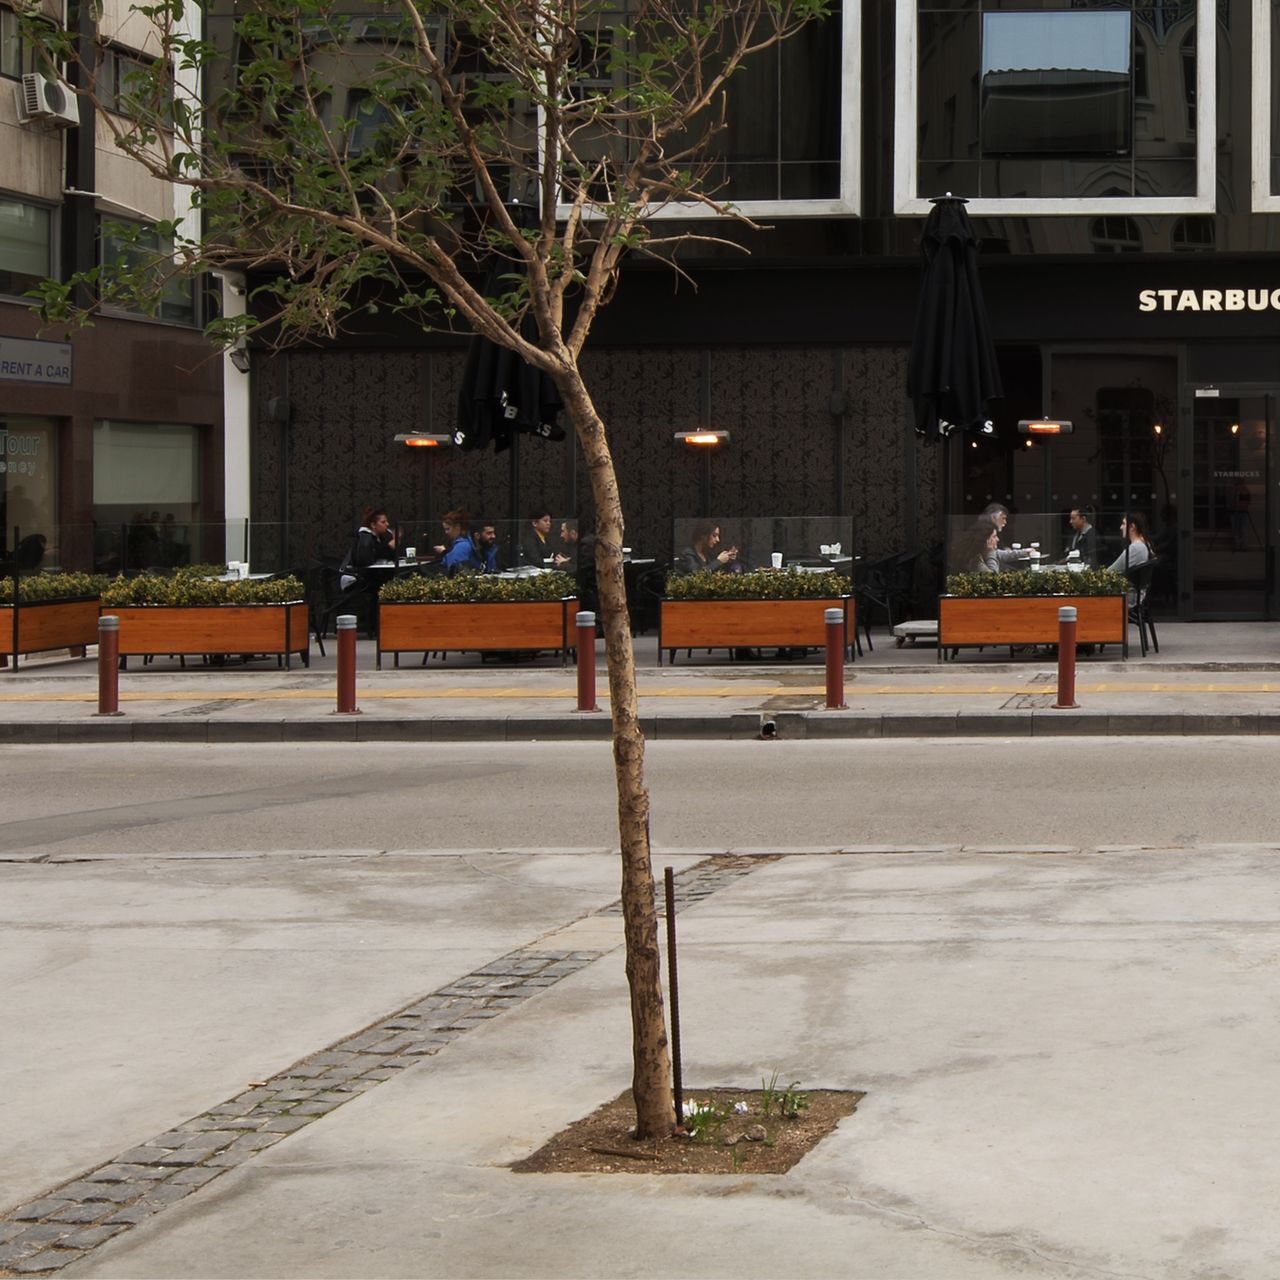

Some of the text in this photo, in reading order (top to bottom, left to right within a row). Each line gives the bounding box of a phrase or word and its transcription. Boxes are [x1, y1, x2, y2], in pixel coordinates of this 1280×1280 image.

[1, 361, 70, 378] RENT A CAR
[0, 429, 41, 455] Tour
